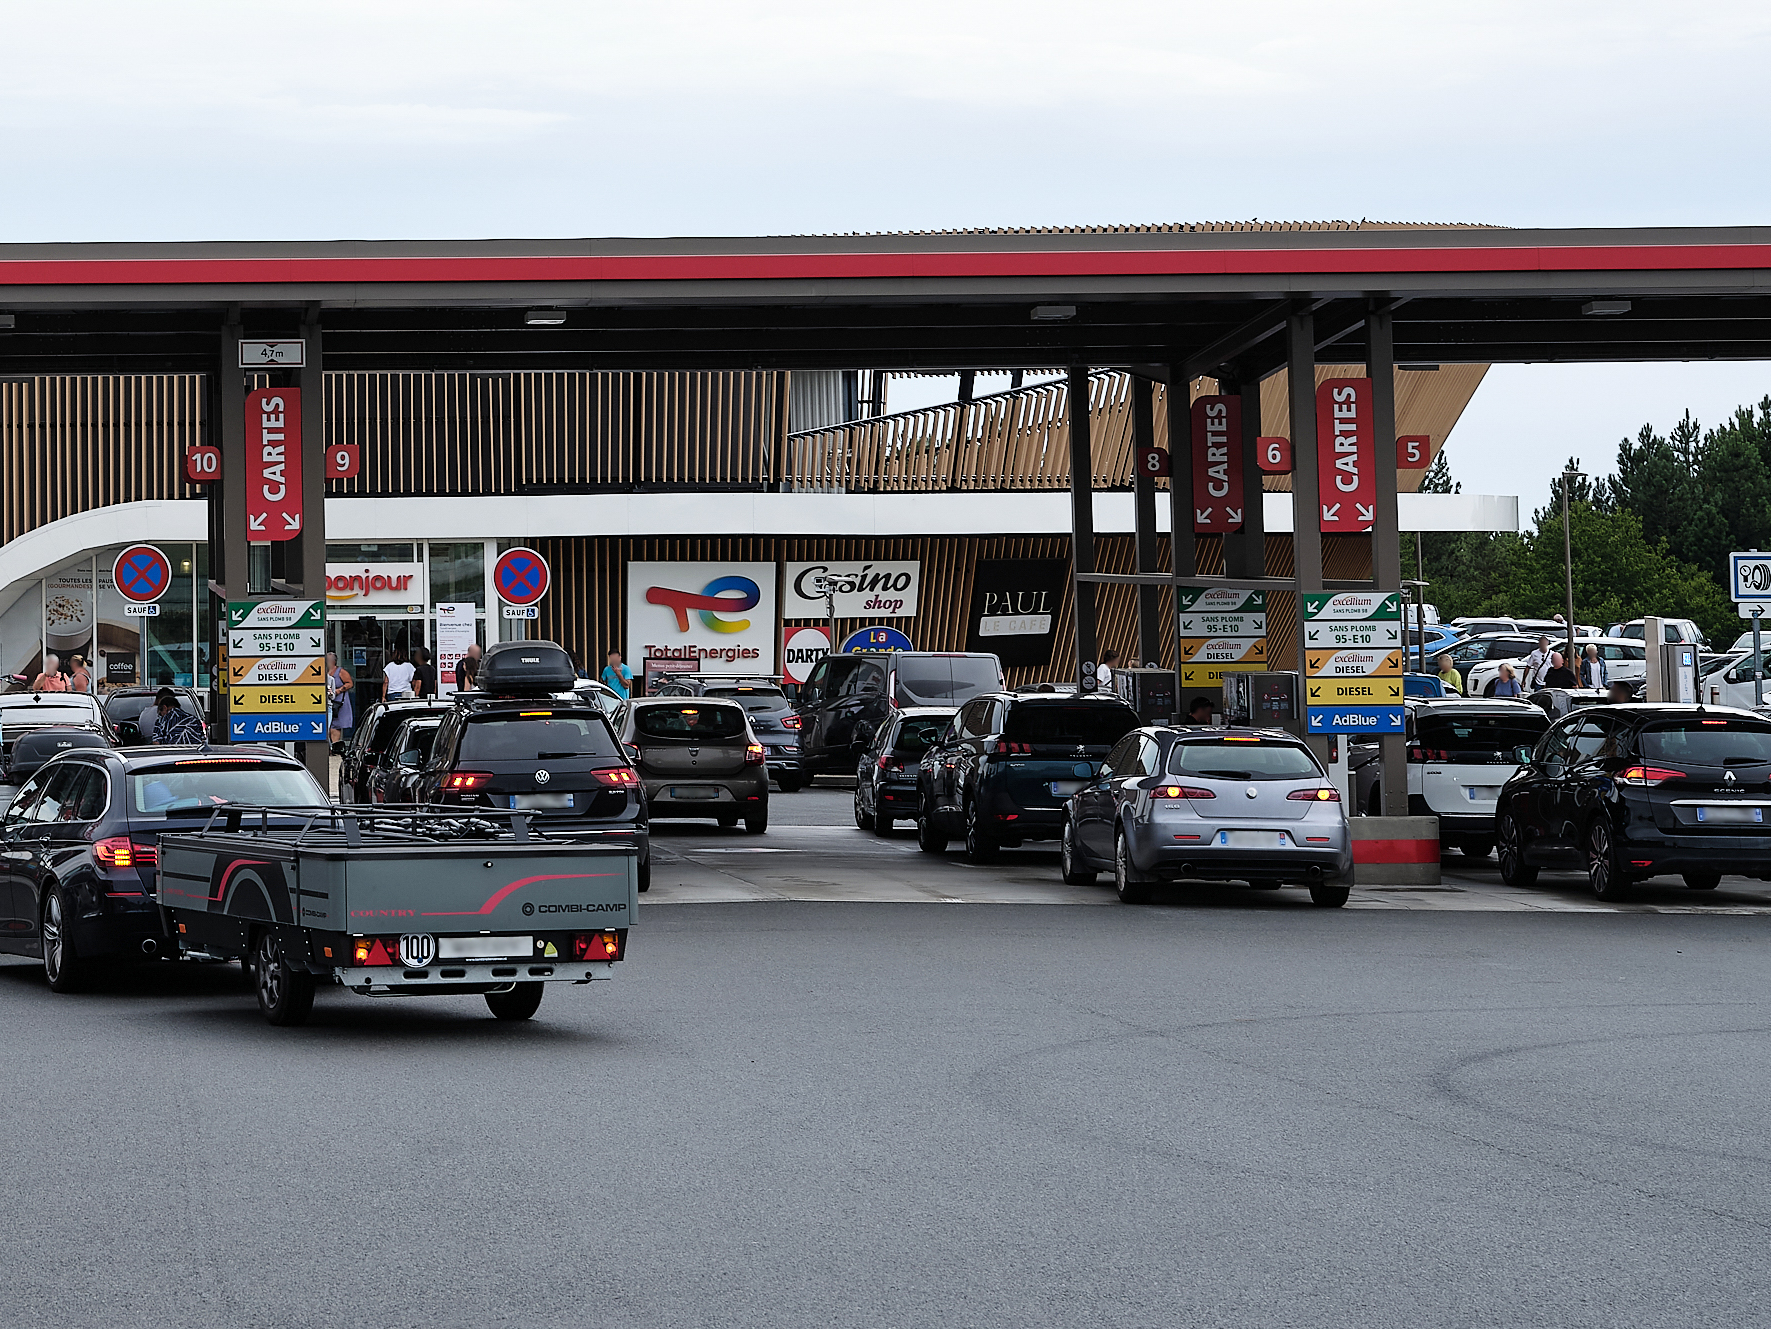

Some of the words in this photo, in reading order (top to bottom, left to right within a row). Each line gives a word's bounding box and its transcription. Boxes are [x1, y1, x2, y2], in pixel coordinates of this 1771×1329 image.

[1333, 386, 1358, 492] CARTES
[261, 396, 286, 502] CARTES
[1207, 402, 1228, 498] CARTES
[1267, 444, 1281, 464] 6
[1407, 442, 1420, 462] 5
[191, 452, 217, 473] 10
[336, 451, 350, 471] 9
[1147, 453, 1160, 471] 8
[794, 564, 911, 600] Csino
[982, 591, 1053, 614] PAUL
[1205, 591, 1239, 599] excellium
[1333, 598, 1371, 606] excellium
[257, 606, 296, 614] excellium
[864, 594, 903, 614] shop
[984, 620, 1000, 632] LE
[1009, 617, 1046, 631] CAFÉ
[1207, 624, 1239, 632] 95-E10
[870, 632, 886, 642] La
[1335, 635, 1371, 643] 95-E10
[259, 643, 294, 651] 95-E10
[644, 644, 759, 662] TotalEnergies
[1206, 642, 1241, 650] excellium
[786, 648, 830, 663] DARTY
[1334, 654, 1373, 662] excellium
[258, 662, 296, 670] excellium
[1337, 687, 1373, 696] DIESEL
[260, 695, 295, 704] DIESEL
[350, 910, 416, 918] COUNTRY
[538, 903, 627, 913] COMBI-CAMP
[403, 935, 430, 959] 100
